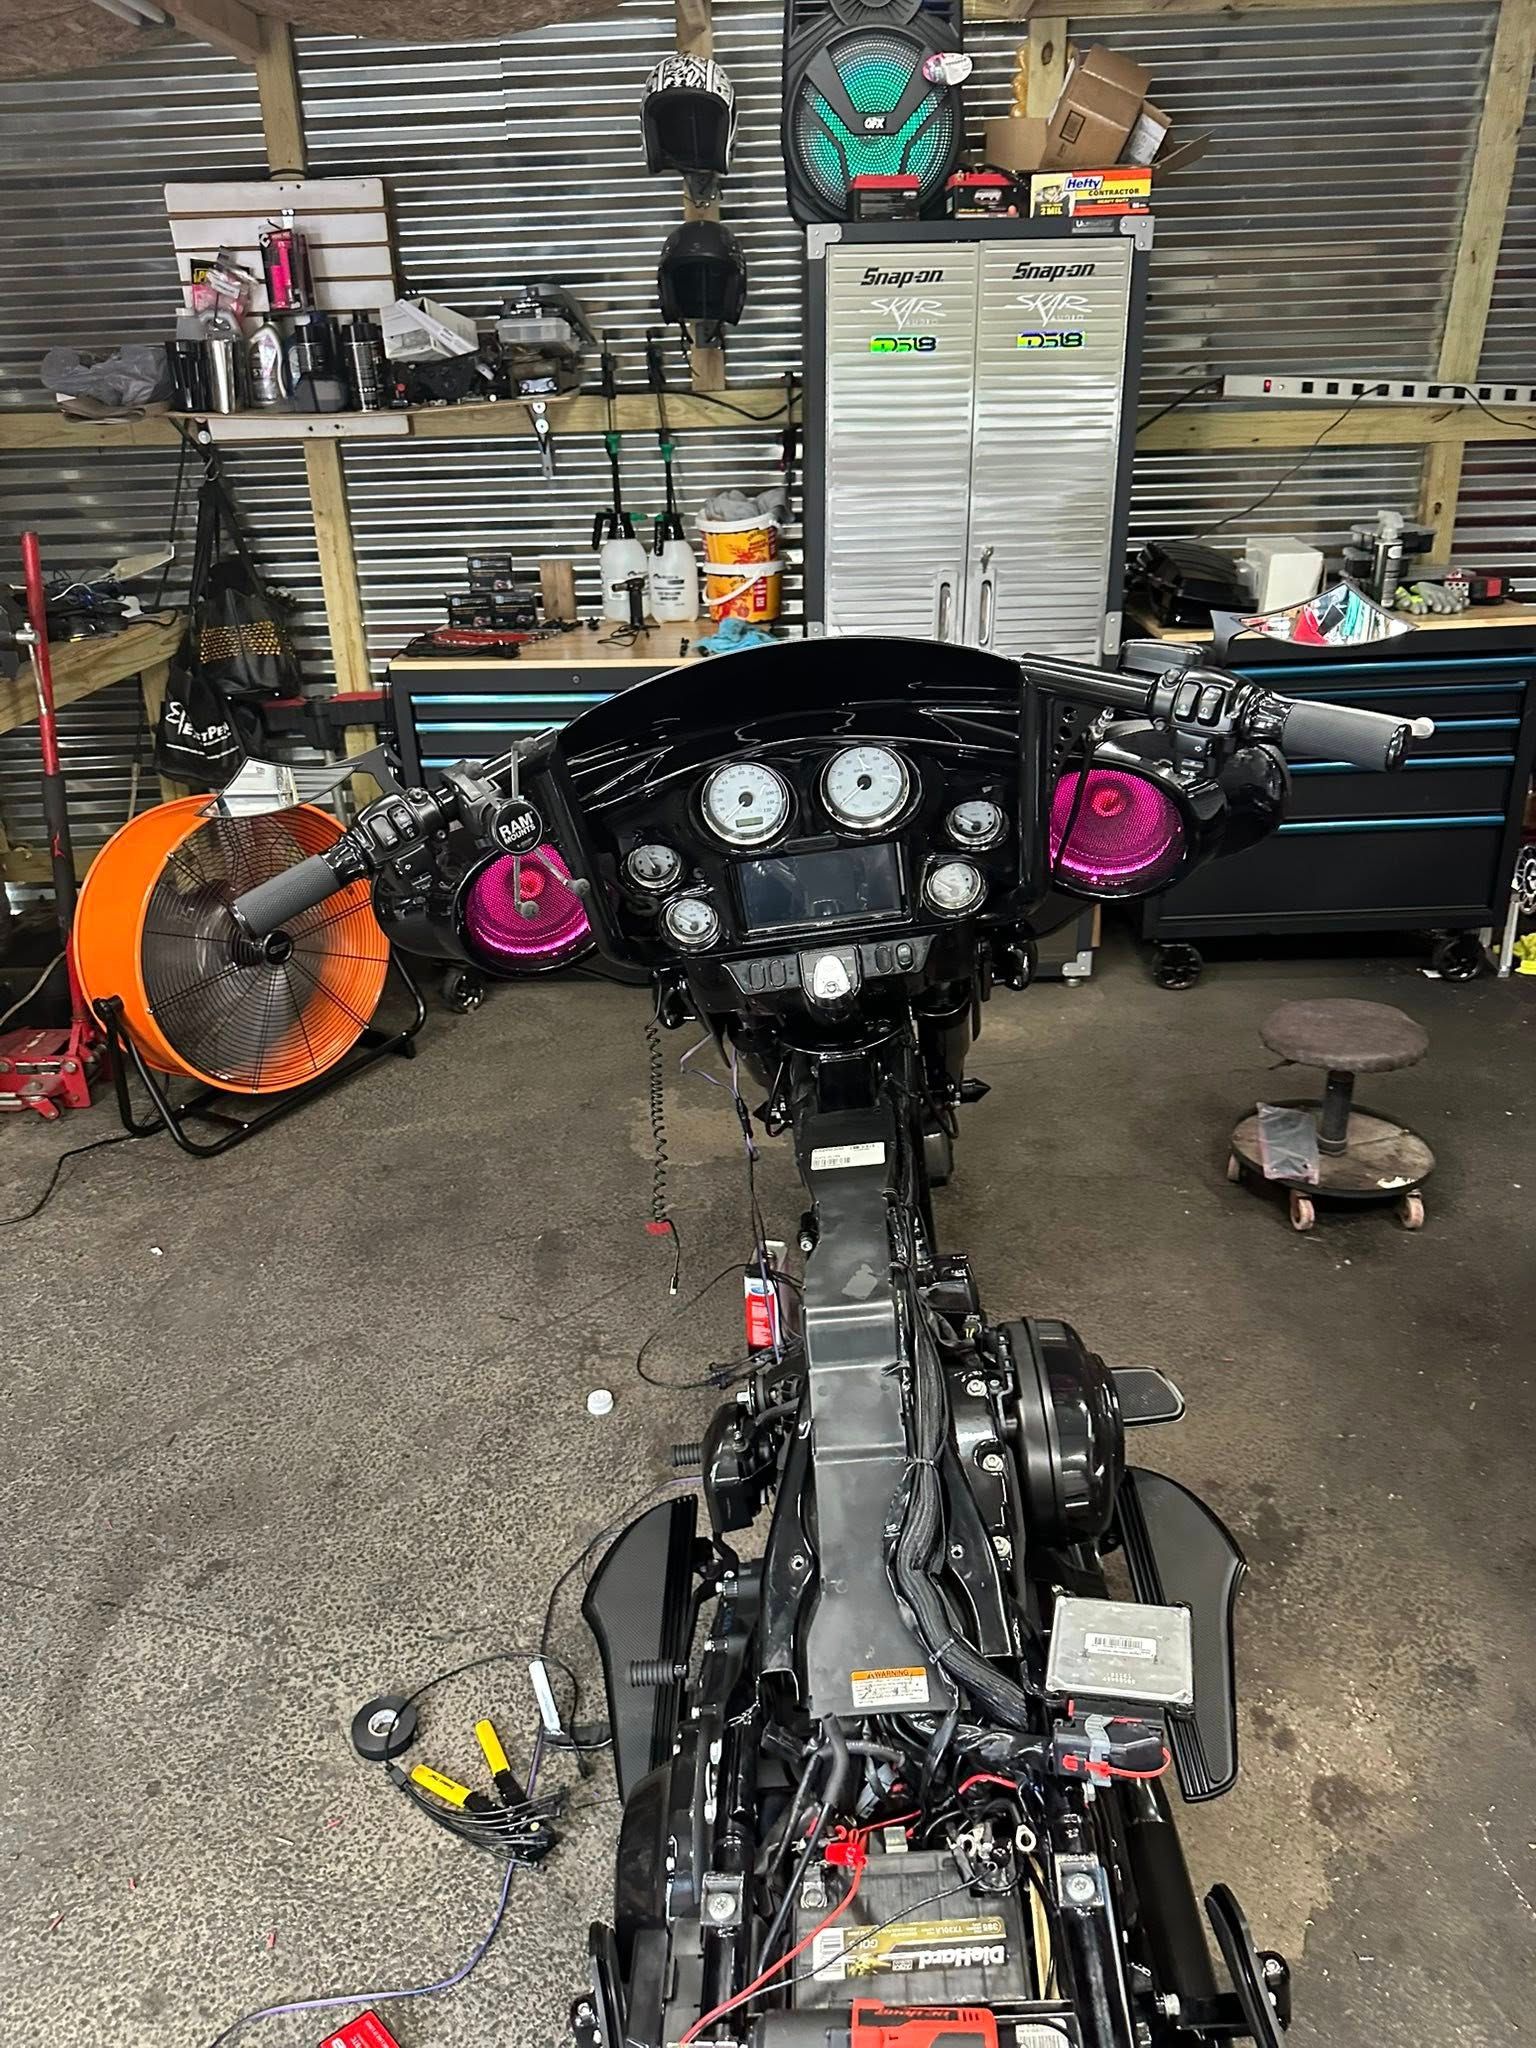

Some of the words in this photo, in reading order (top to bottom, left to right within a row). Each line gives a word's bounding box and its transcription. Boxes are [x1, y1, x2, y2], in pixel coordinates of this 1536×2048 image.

[1067, 177, 1101, 190] Hefty
[1088, 188, 1140, 197] CONTRACTOR
[1047, 206, 1063, 215] MIL
[861, 267, 944, 288] Snap-on
[1012, 262, 1095, 282] Snap-on
[504, 823, 536, 844] MOUNTS
[875, 1669, 910, 1679] WARNING
[918, 1945, 1005, 1970] DieHard
